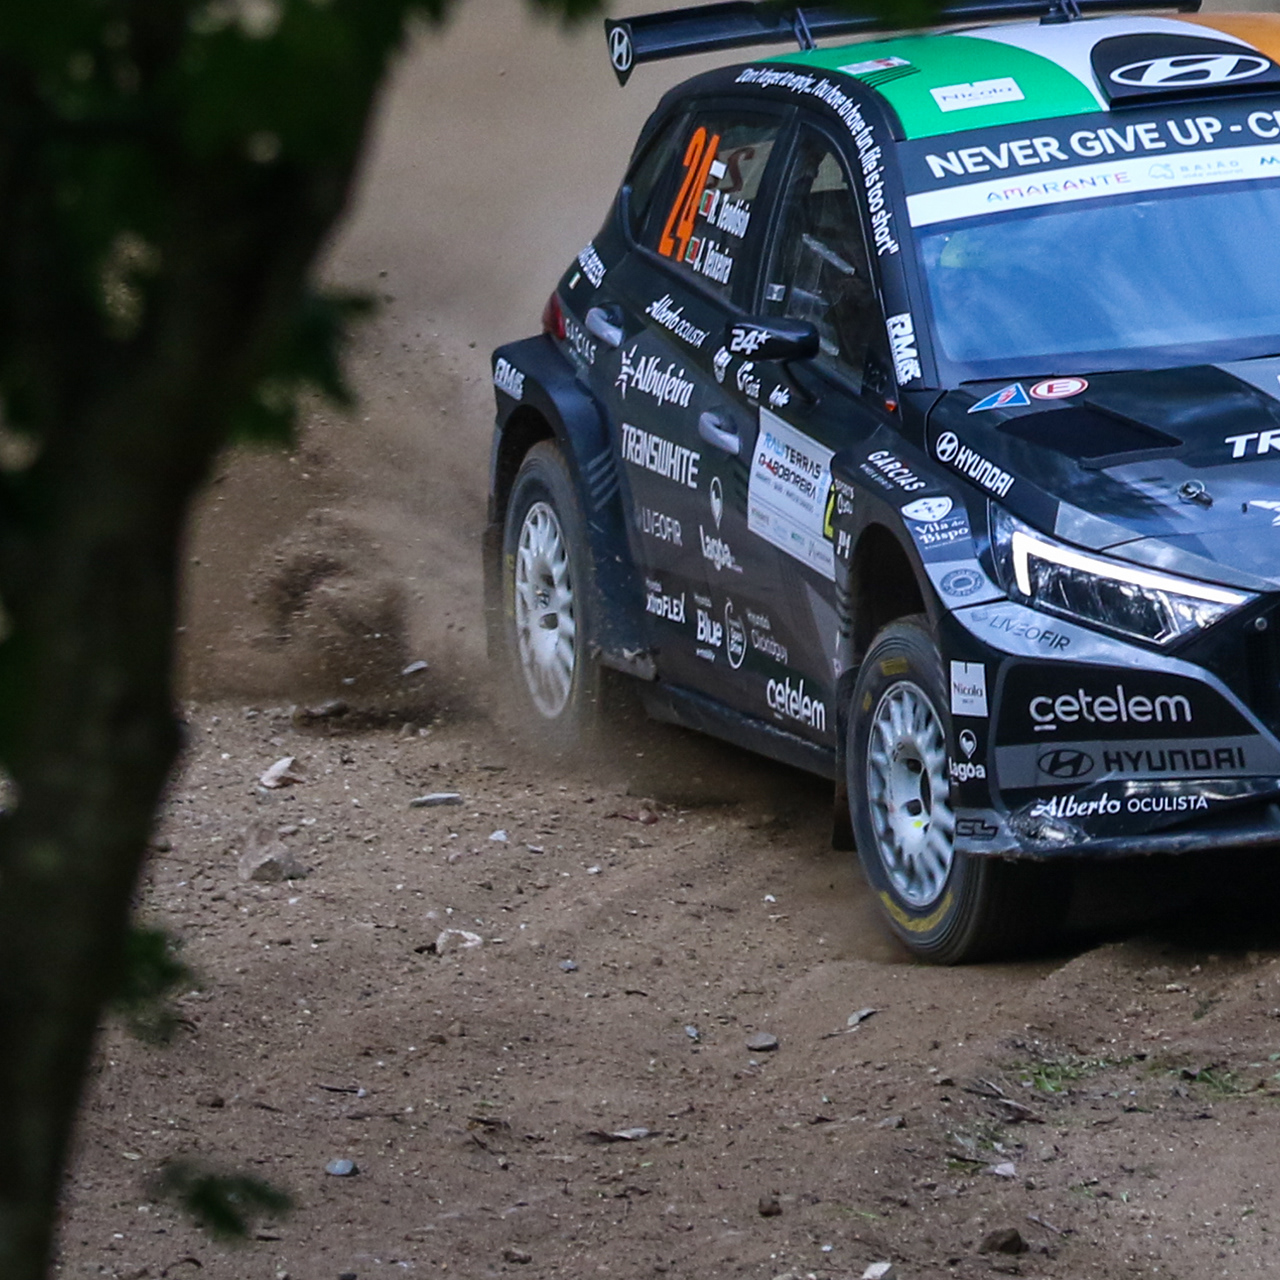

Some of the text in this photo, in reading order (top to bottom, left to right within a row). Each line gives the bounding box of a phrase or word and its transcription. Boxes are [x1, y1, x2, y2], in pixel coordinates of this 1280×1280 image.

[925, 134, 1063, 178] NEVER
[1070, 120, 1161, 160] GIVE
[1167, 117, 1223, 147] UP
[658, 126, 720, 263] 24
[867, 181, 885, 213] too
[986, 171, 1132, 204] AMARANTE
[630, 355, 696, 409] Albufeira
[954, 445, 1015, 498] HYUNDAI
[915, 520, 949, 535] Vila
[919, 527, 969, 544] Bispo
[695, 609, 723, 648] Blue
[767, 676, 826, 732] cetelem
[953, 682, 983, 699] Nicola
[1029, 684, 1192, 726] cetelem
[1103, 746, 1246, 774] HYUNDAI
[1030, 792, 1209, 820] Alberto OCULISTA
